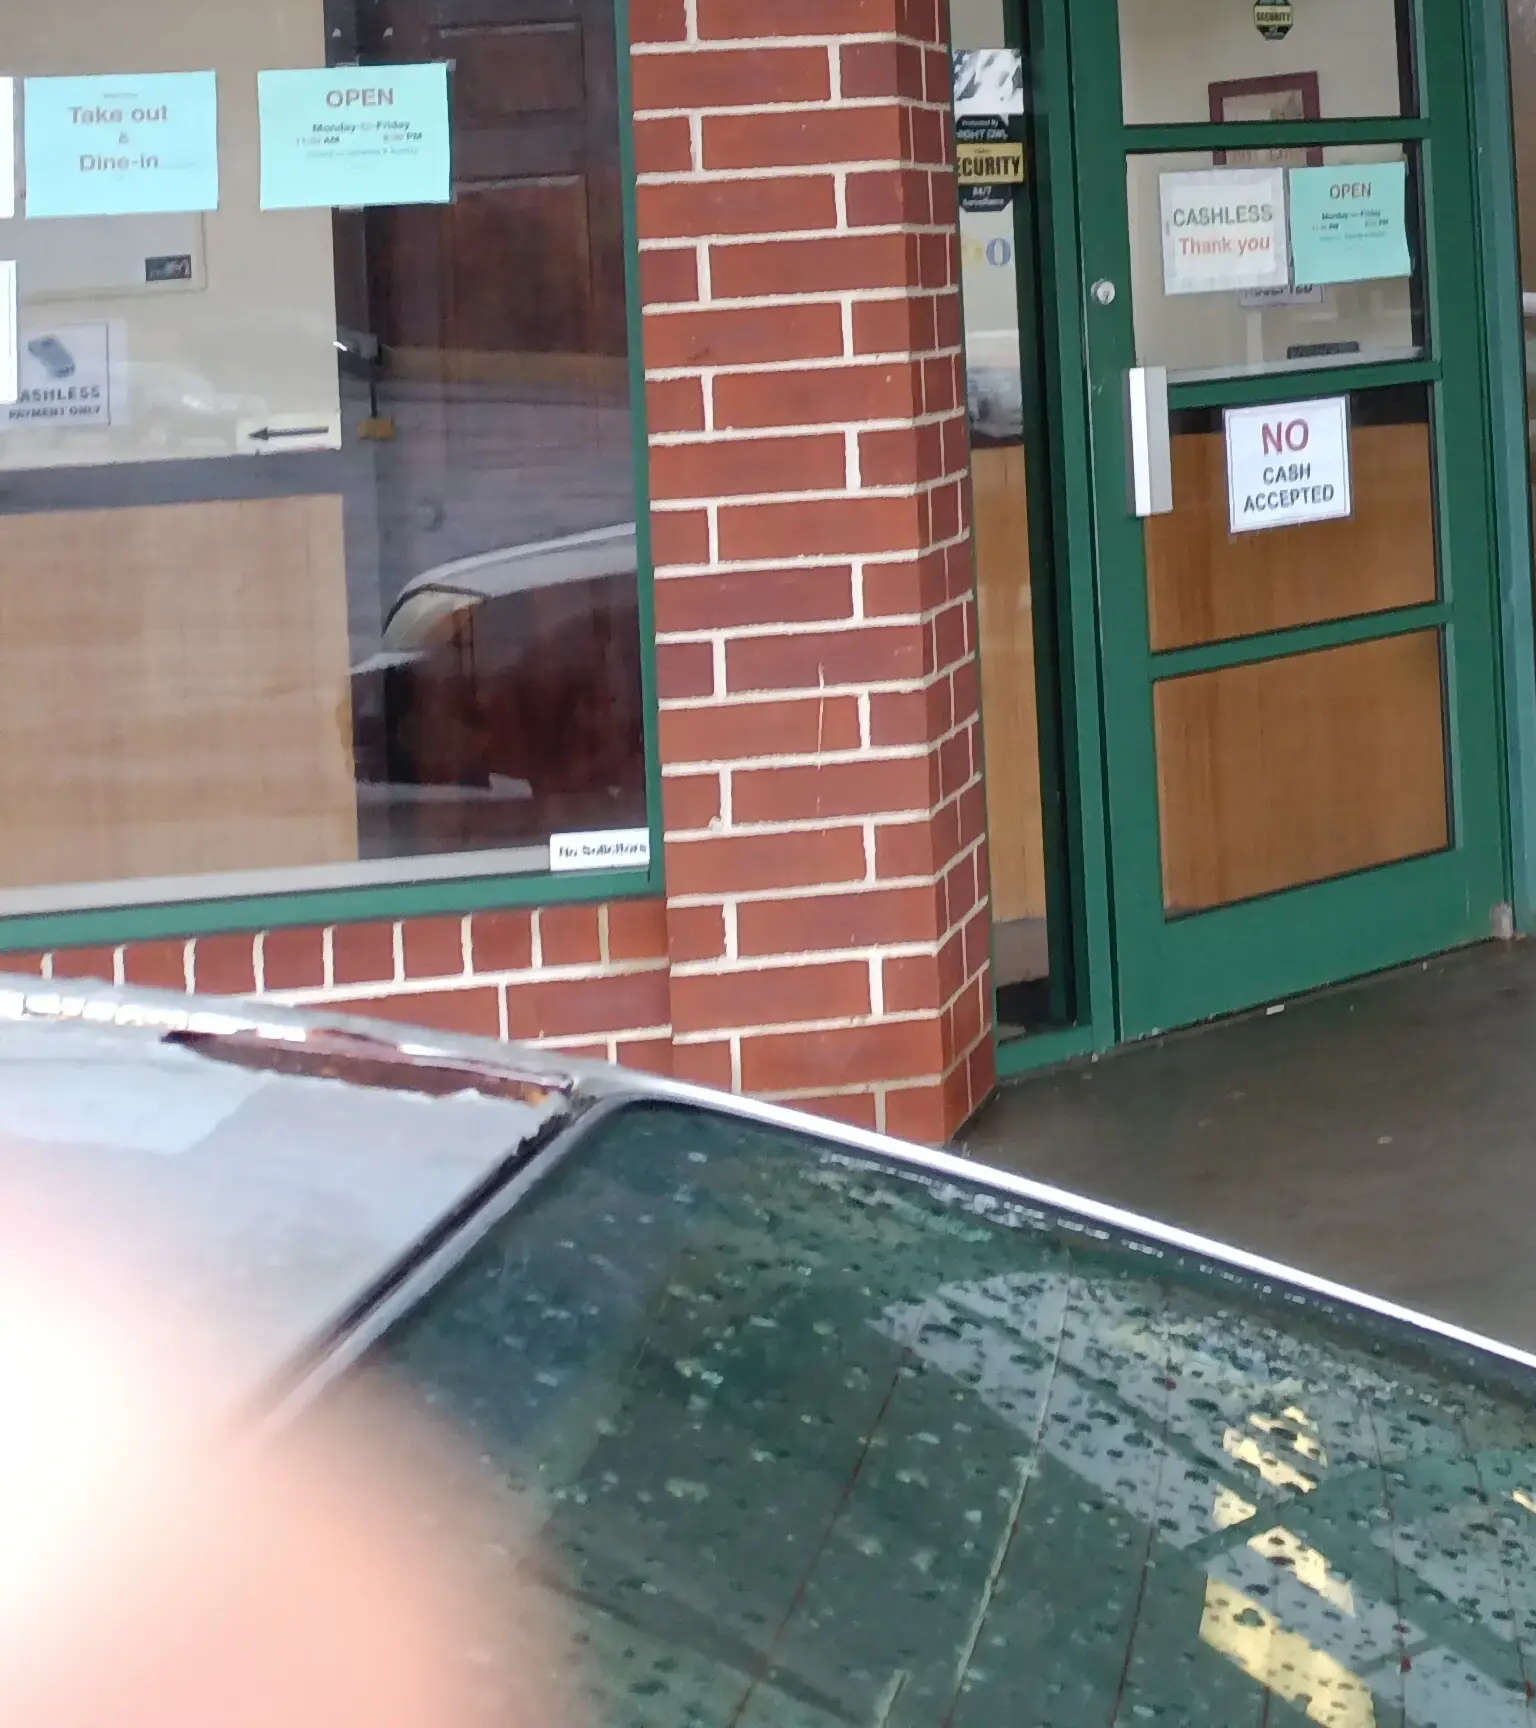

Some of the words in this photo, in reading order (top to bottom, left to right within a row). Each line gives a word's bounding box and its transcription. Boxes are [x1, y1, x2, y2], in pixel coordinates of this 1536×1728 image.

[326, 88, 394, 108] OPEN
[69, 106, 123, 124] Take
[131, 105, 167, 122] out
[312, 122, 356, 133] Monday
[376, 120, 410, 132] Friday
[79, 154, 159, 171] Dine-in
[1329, 182, 1372, 200] OPEN
[1173, 204, 1273, 228] CASHLESS
[1179, 237, 1232, 256] Thank
[1237, 236, 1271, 256] you
[19, 385, 101, 405] ASHLESS
[1261, 418, 1310, 455] NO
[1263, 462, 1311, 485] CASH
[1243, 484, 1334, 513] ACCEPTED
